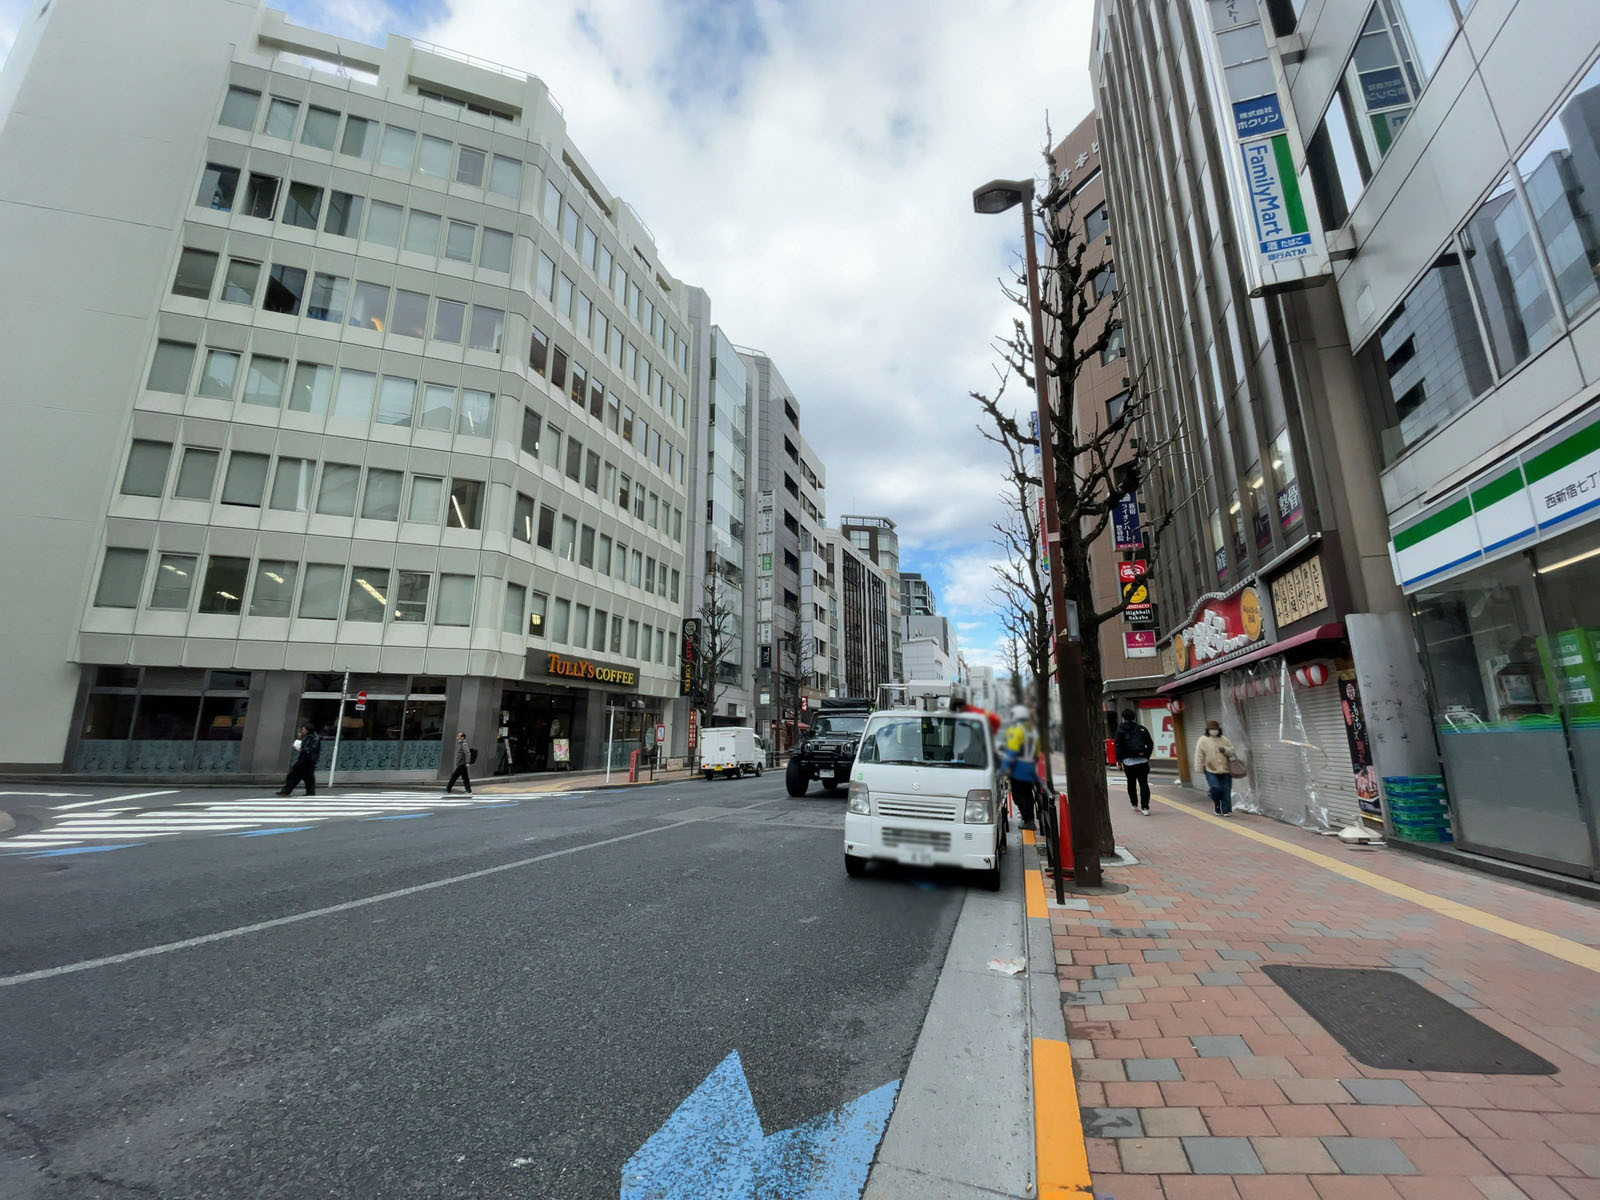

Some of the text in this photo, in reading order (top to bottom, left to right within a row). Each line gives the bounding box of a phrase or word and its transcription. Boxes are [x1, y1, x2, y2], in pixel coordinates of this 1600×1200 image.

[1237, 113, 1279, 129] ホクリン
[1239, 106, 1273, 119] 株式会社
[1248, 145, 1284, 237] FamilyMart
[1267, 237, 1304, 251] 酒 たばこ
[1544, 471, 1600, 509] 西新宿七丁
[1122, 503, 1131, 541] ライオンハート
[547, 653, 634, 685] TULLY'S COFFEE
